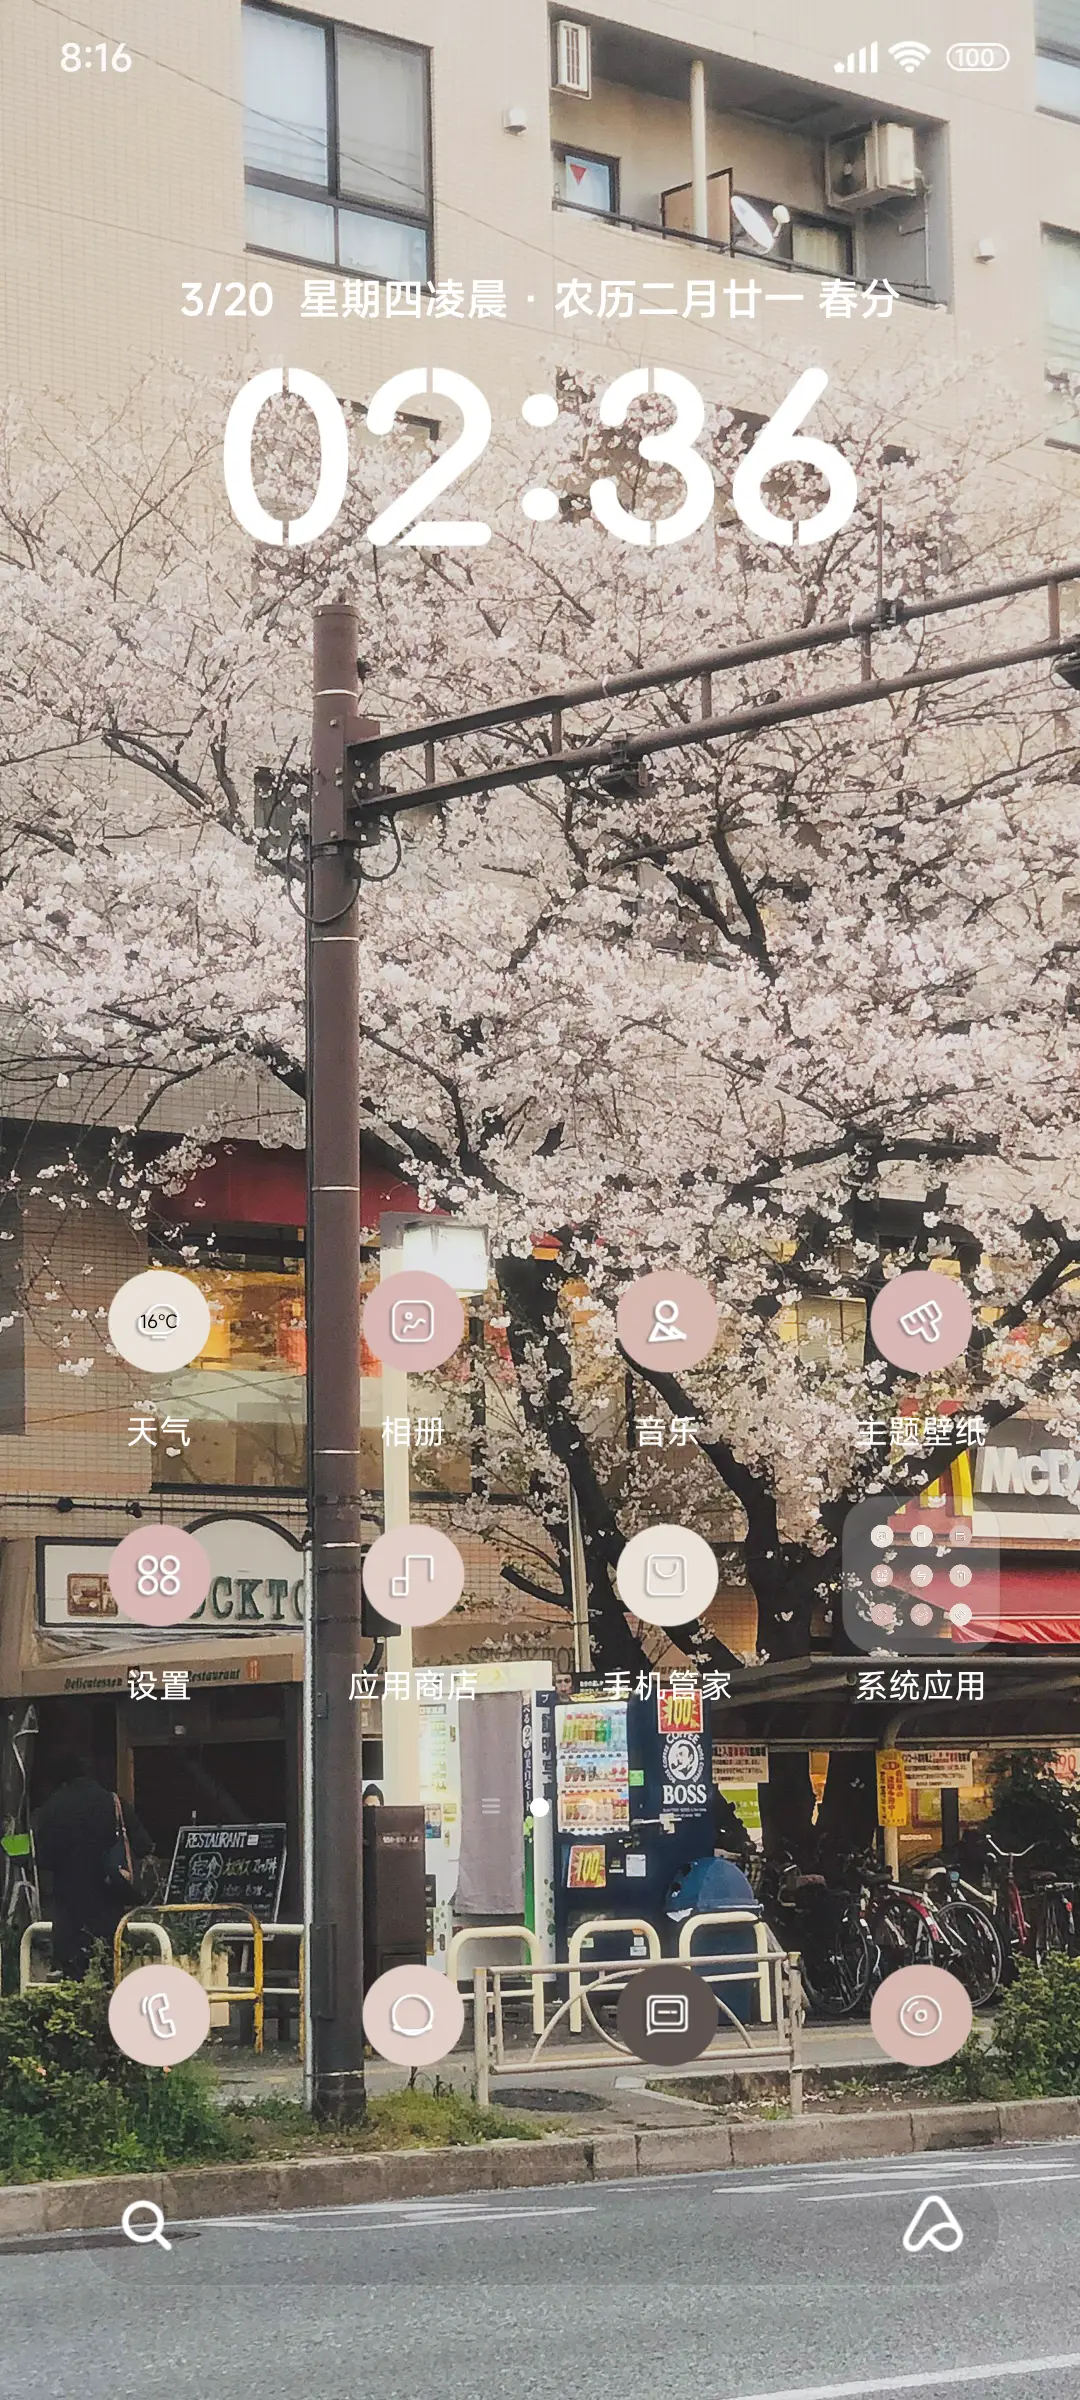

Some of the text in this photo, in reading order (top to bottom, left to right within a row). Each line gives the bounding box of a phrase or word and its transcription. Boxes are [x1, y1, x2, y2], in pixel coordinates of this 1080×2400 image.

[975, 1446, 1080, 1496] McD
[663, 1784, 707, 1804] BOSS
[185, 1831, 248, 1849] RESTAURANT
